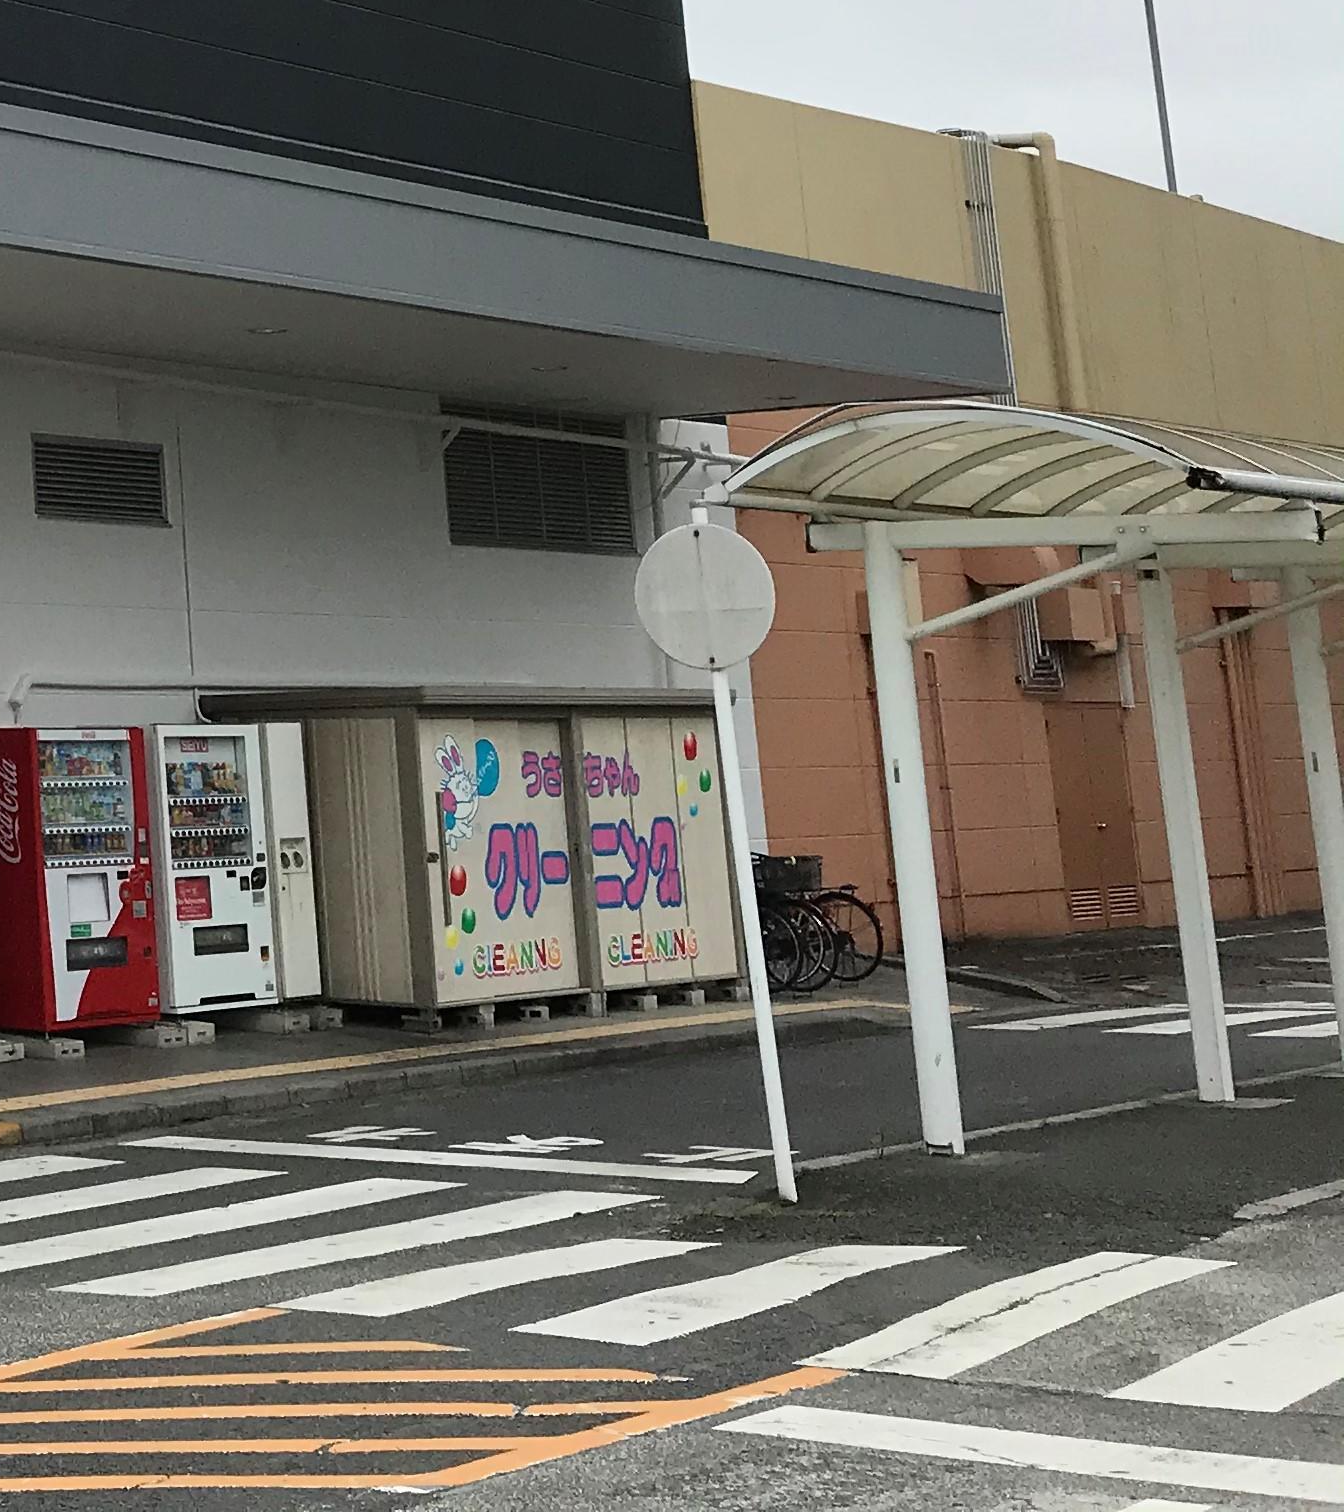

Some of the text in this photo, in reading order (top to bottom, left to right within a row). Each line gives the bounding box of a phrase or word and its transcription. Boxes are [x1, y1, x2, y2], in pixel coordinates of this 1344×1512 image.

[485, 816, 682, 921] クリーニング
[473, 936, 562, 978] CLEANNG
[608, 928, 699, 967] CLEANING
